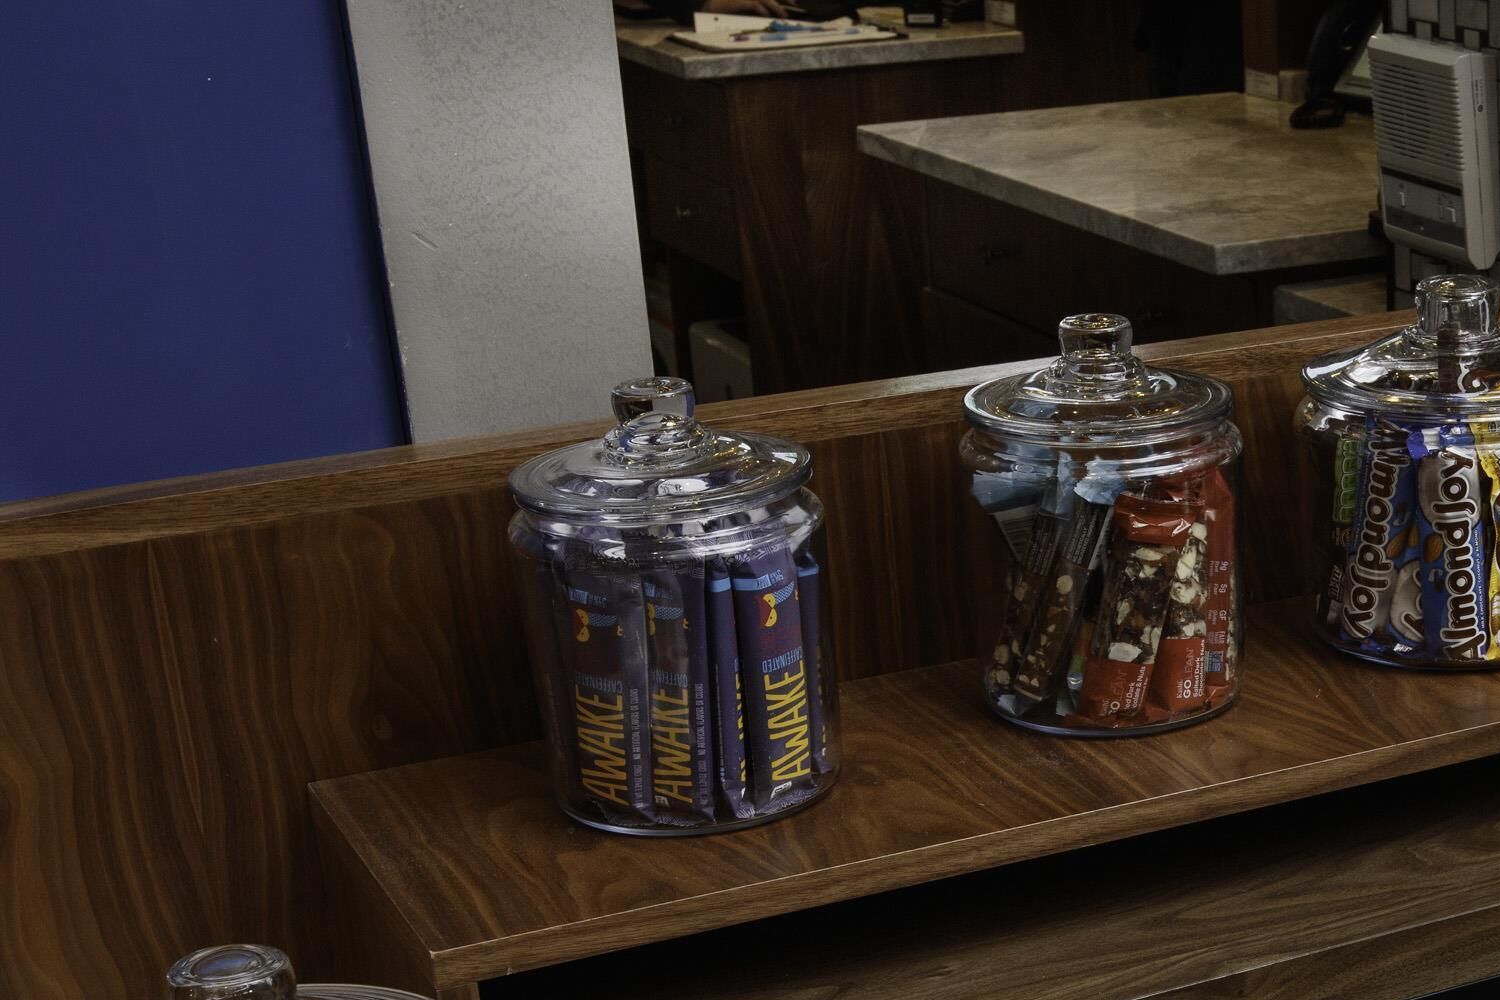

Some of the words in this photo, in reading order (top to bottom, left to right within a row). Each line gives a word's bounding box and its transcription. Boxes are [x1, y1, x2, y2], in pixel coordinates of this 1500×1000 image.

[1432, 447, 1478, 518] Joy
[1219, 561, 1229, 571] 9g
[1218, 583, 1228, 593] 5g
[1343, 560, 1391, 638] Joy
[1432, 517, 1488, 661] Almond
[1219, 610, 1228, 621] GF
[762, 646, 803, 674] CAFFEINATED
[1136, 666, 1146, 683] Nuts
[1126, 681, 1135, 698] Dark
[1193, 675, 1201, 698] Salted
[630, 711, 640, 730] FLAVORS
[696, 706, 705, 725] FLAVORS
[764, 660, 812, 781] AWAKE
[575, 684, 630, 806] AWAKE
[652, 688, 694, 804] AWAKE
